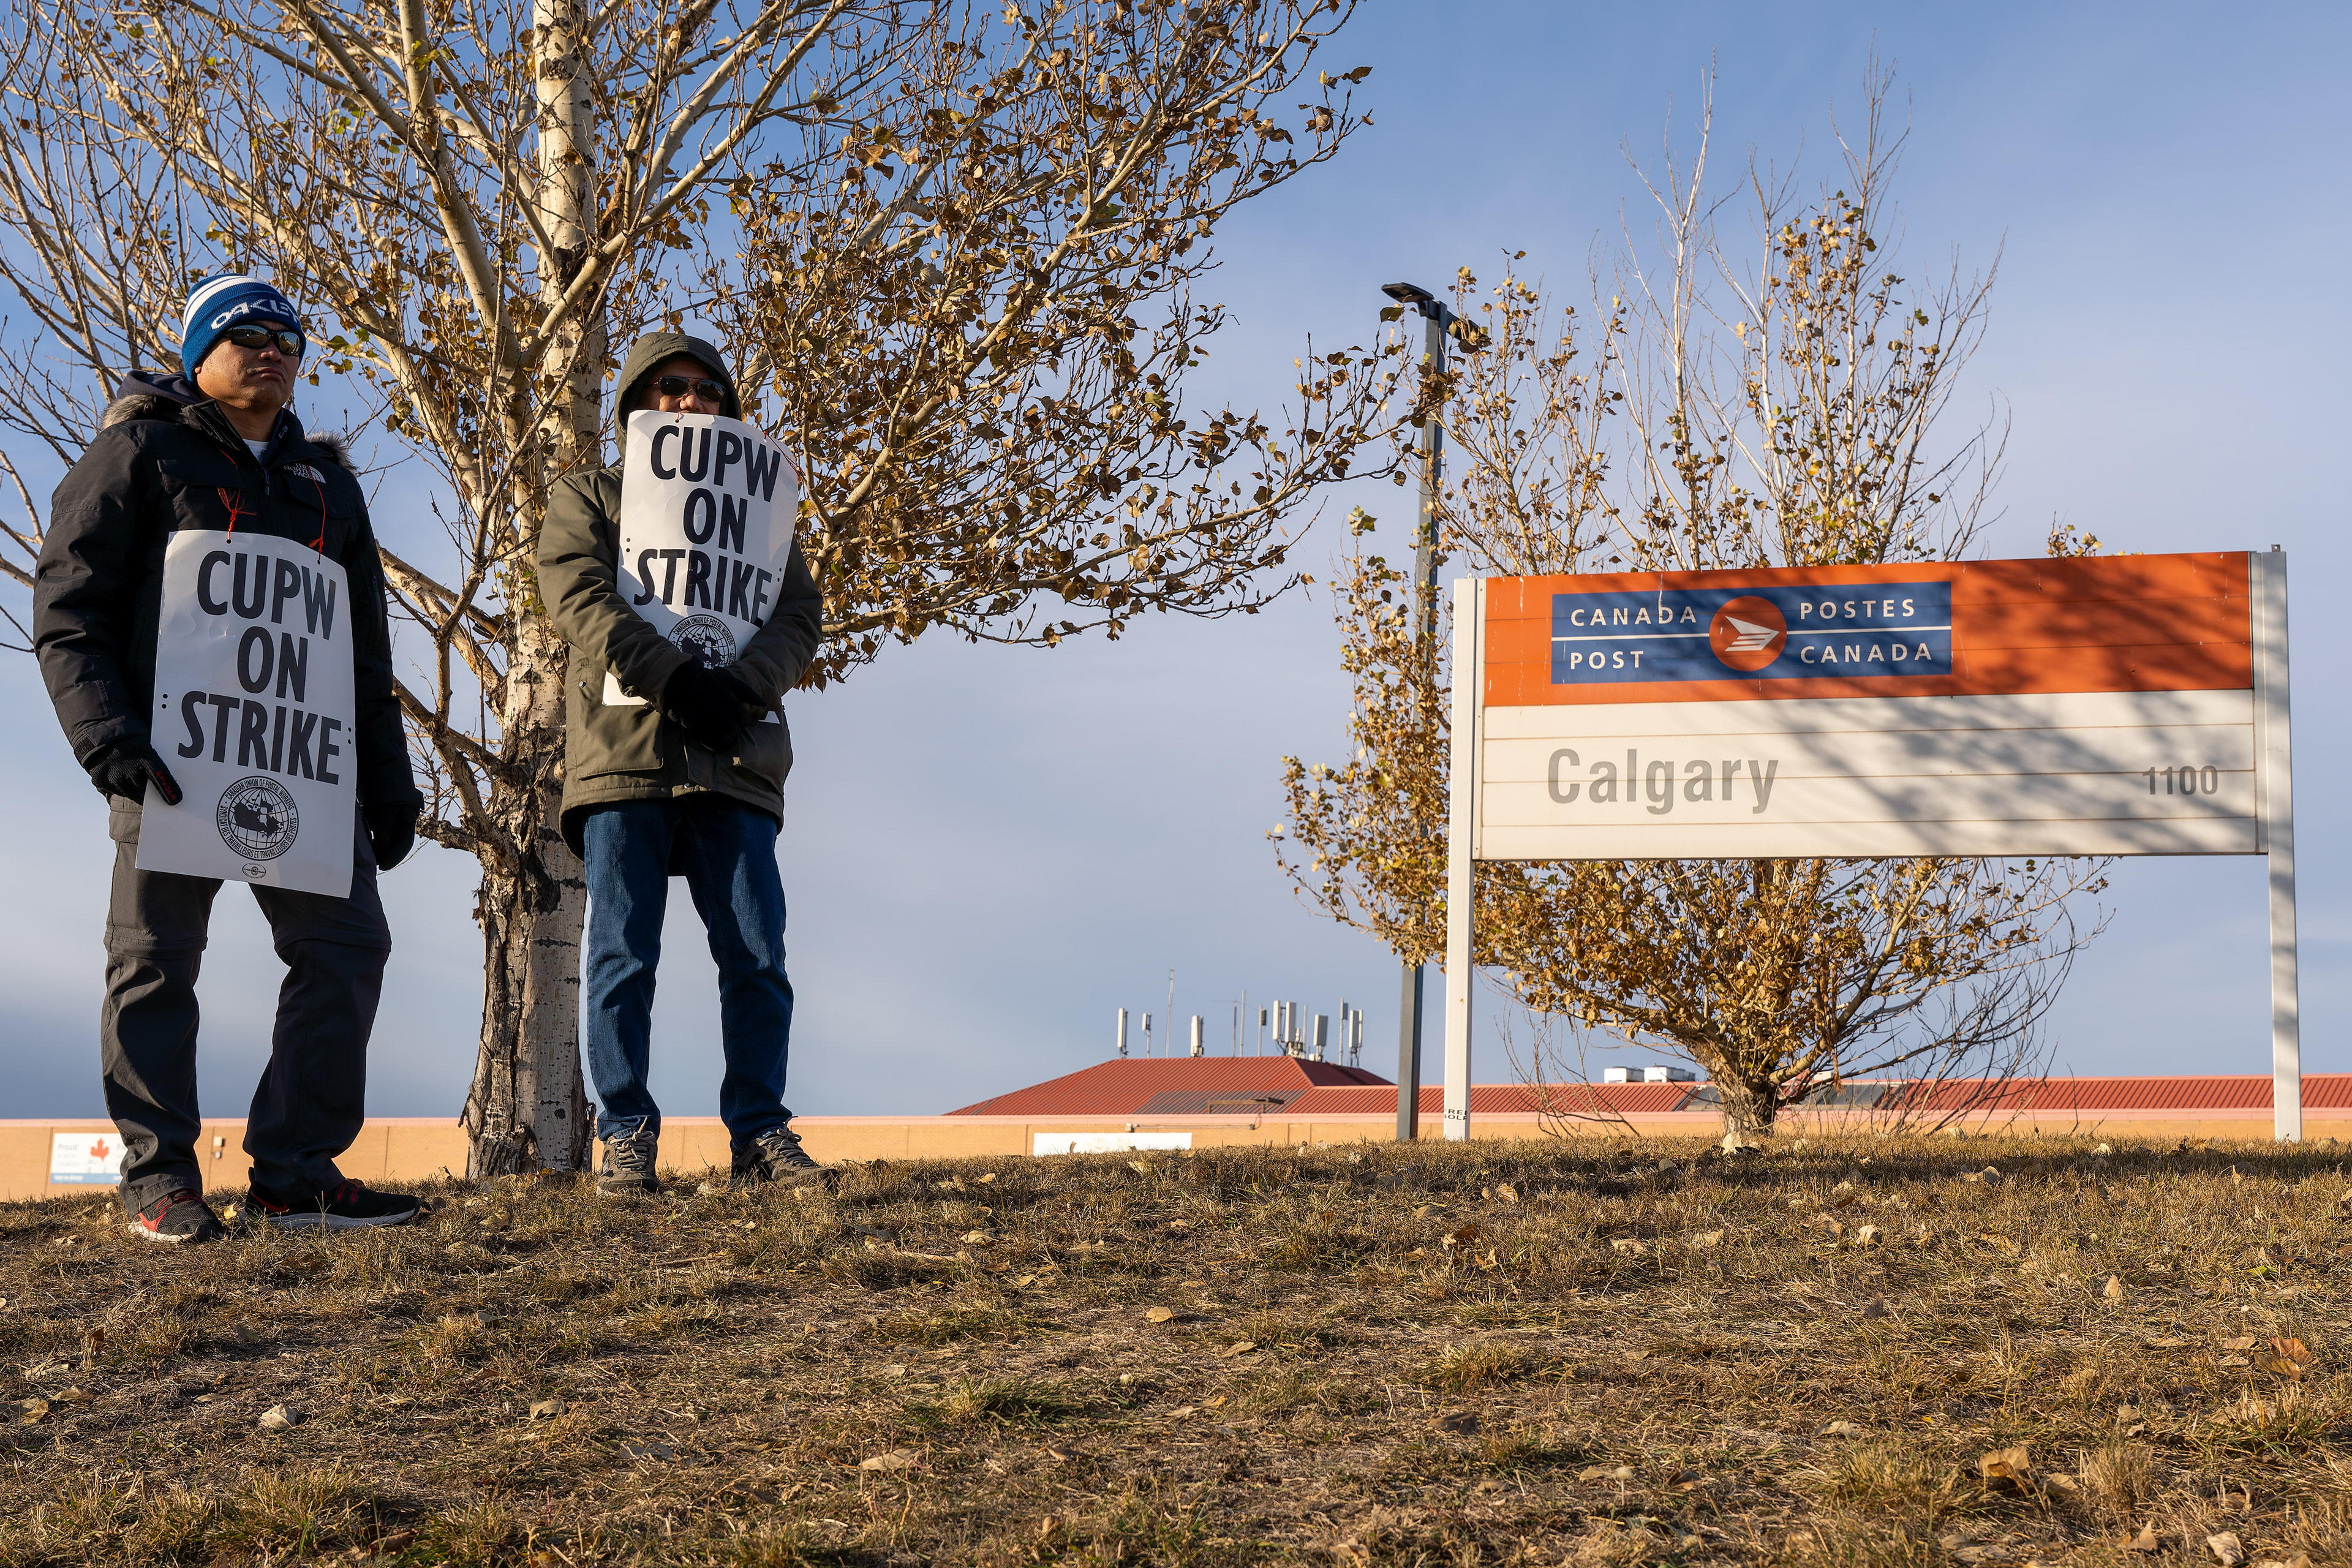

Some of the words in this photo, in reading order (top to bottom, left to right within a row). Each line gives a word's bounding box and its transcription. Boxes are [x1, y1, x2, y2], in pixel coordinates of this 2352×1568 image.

[283, 465, 311, 474] NORTH
[293, 470, 313, 480] FACE
[650, 424, 781, 502] CUPW
[683, 488, 748, 554] ON
[197, 550, 336, 641] CUPW
[633, 548, 772, 628] STRIKE
[1570, 605, 1697, 627] CANADA
[1800, 598, 1915, 620] POSTES
[673, 619, 691, 635] CANADIAN
[690, 616, 704, 625] UNION
[709, 617, 723, 631] POSTAL
[721, 627, 735, 646] WORKERS
[237, 626, 308, 703] ON
[1570, 650, 1645, 670] POST
[1800, 643, 1932, 664] CANADA
[178, 691, 342, 785] STRIKE
[1548, 748, 1779, 815] Calgary
[2143, 766, 2218, 795] 1100
[225, 782, 246, 800] CANADIAN
[244, 778, 258, 788] UNION
[265, 780, 281, 794] POSTAL
[279, 789, 295, 810] WORKERS
[219, 805, 228, 827] SYNDICAT
[221, 826, 229, 836] DES
[285, 833, 294, 843] DES
[225, 834, 254, 858] TRAVAILLEURS
[260, 840, 290, 859] TRAVAILLEUSES
